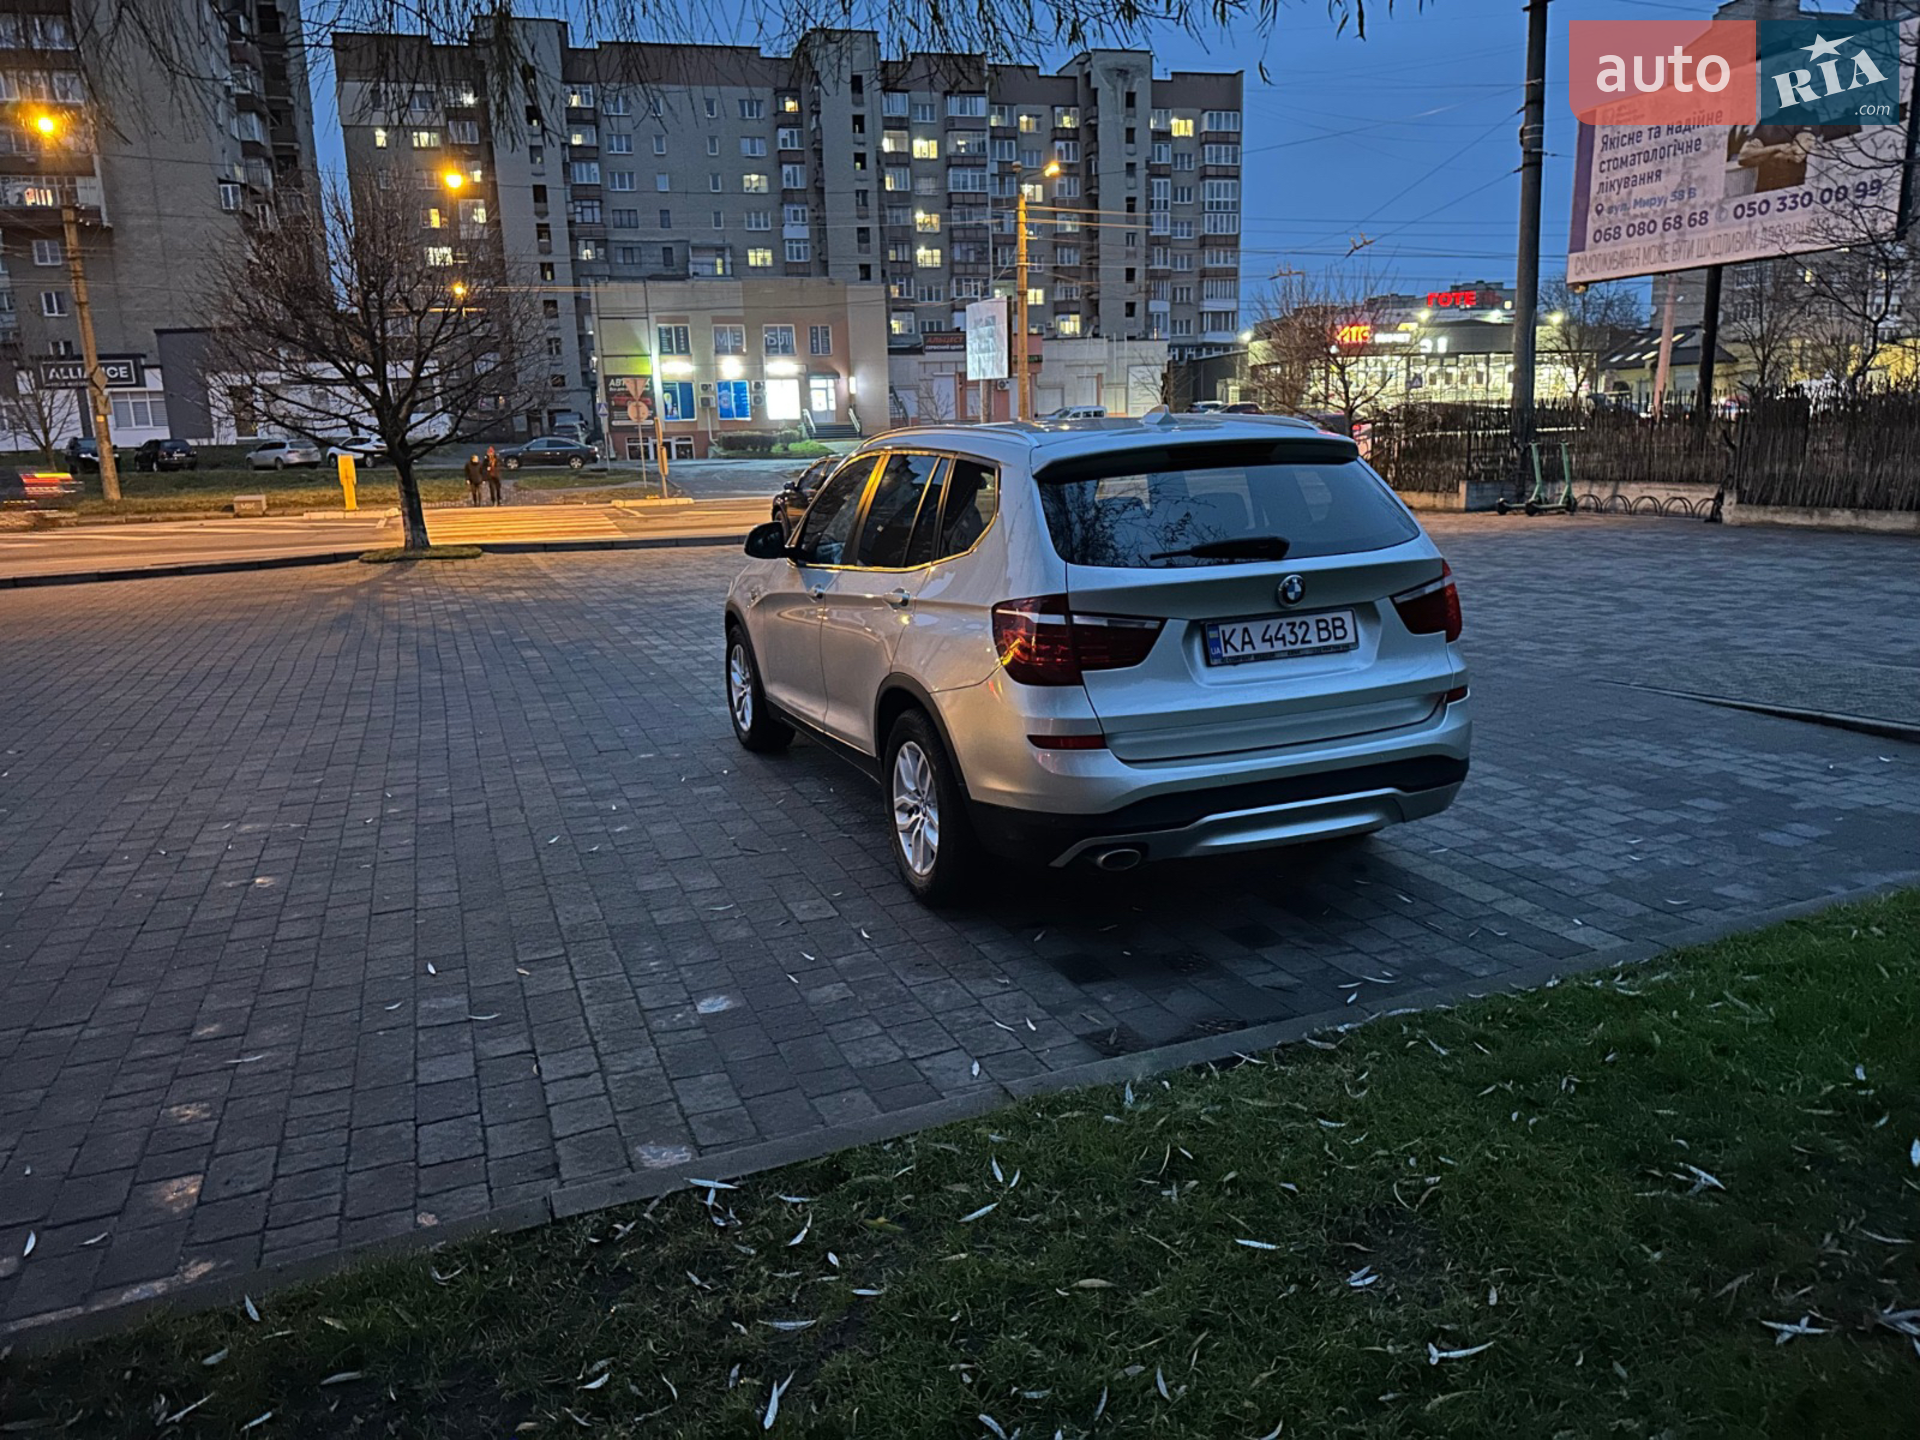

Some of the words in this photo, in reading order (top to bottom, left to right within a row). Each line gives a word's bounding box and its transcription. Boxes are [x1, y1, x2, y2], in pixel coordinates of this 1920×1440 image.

[1600, 129, 1643, 153] Якісне
[1647, 125, 1662, 141] та
[1598, 137, 1702, 174] стоматологічне
[1596, 168, 1662, 195] лікування
[1732, 198, 1771, 220] 050
[1775, 191, 1814, 213] 330
[1819, 185, 1849, 205] 00
[1854, 178, 1883, 199] 99
[1592, 225, 1623, 244] 068
[1625, 218, 1658, 238] 080
[1662, 214, 1684, 233] 68
[1687, 209, 1710, 229] 68
[48, 365, 129, 380] ALLICE
[1210, 646, 1221, 655] UA
[1221, 626, 1256, 654] KA
[1261, 619, 1312, 649] 4432
[1315, 616, 1348, 643] BB
